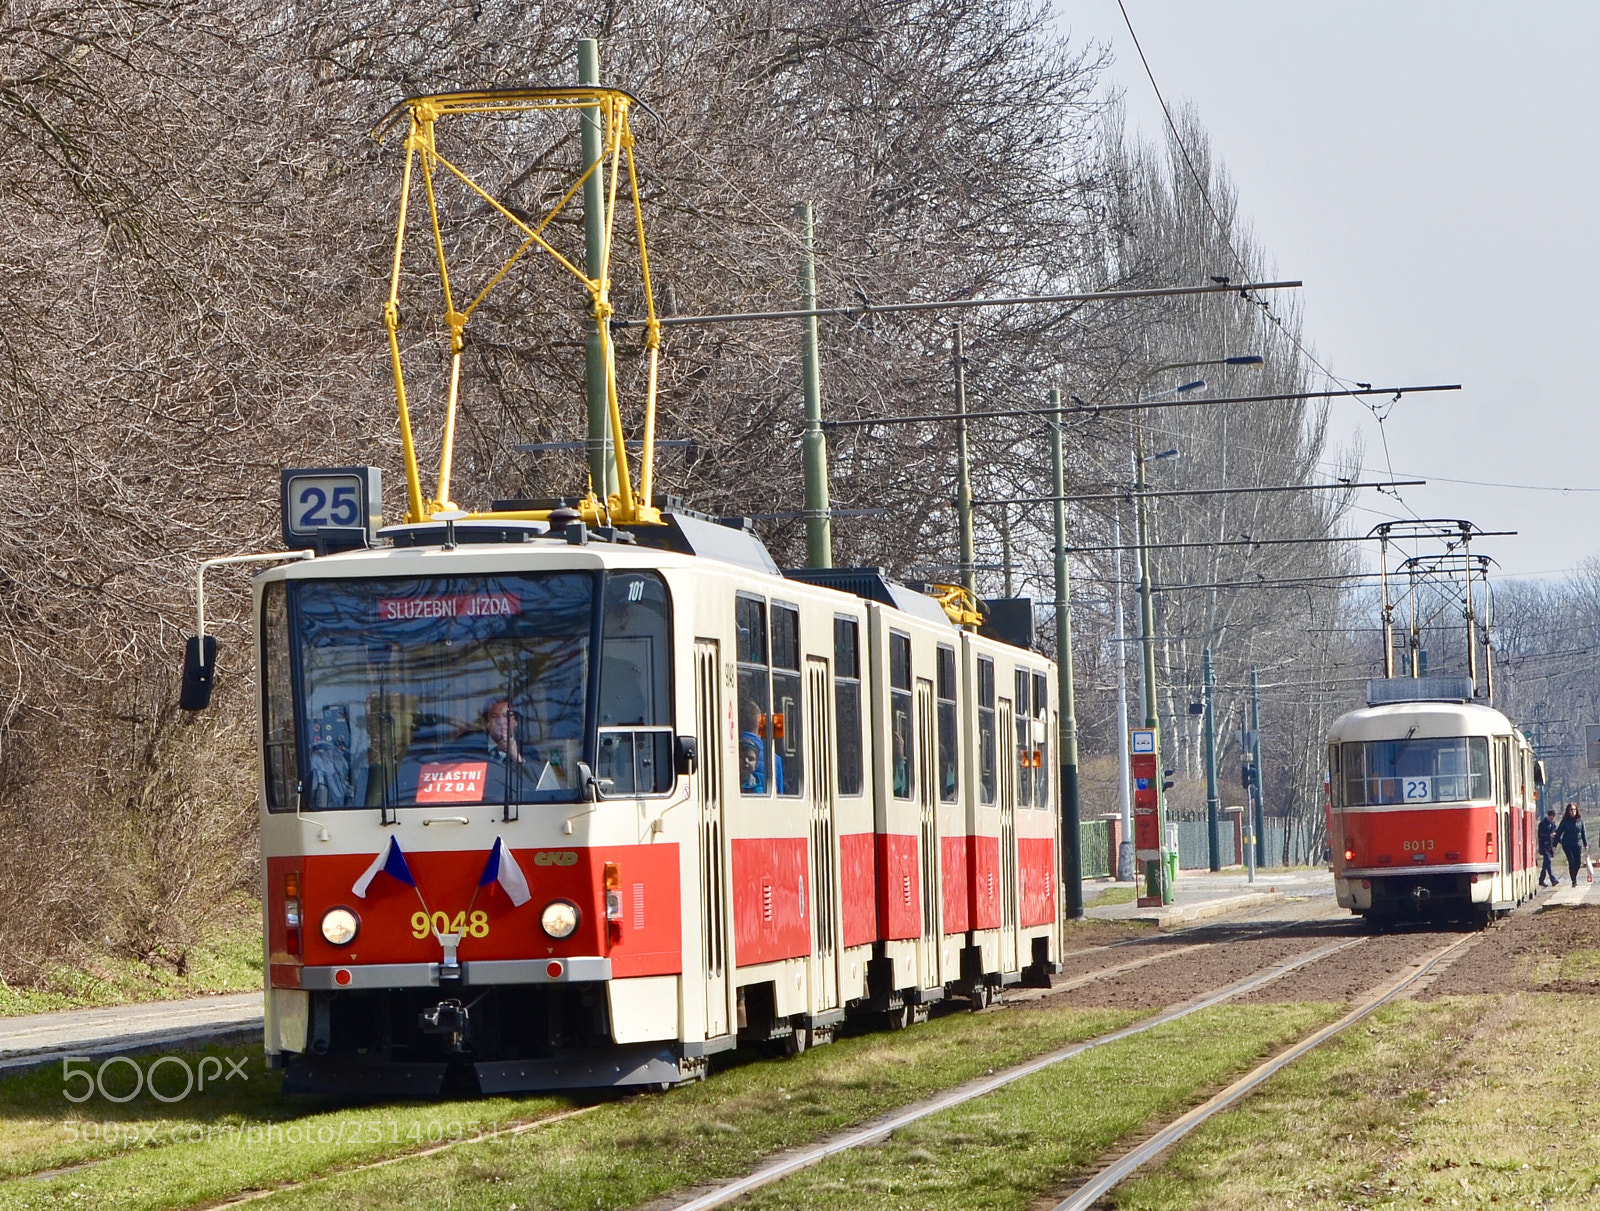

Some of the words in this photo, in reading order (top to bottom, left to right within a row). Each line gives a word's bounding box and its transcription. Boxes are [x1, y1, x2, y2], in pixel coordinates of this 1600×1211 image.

[299, 486, 358, 527] 25
[466, 597, 512, 616] JÍZDA
[1407, 781, 1428, 798] 23
[1404, 840, 1434, 851] 8013
[411, 910, 490, 940] 9048
